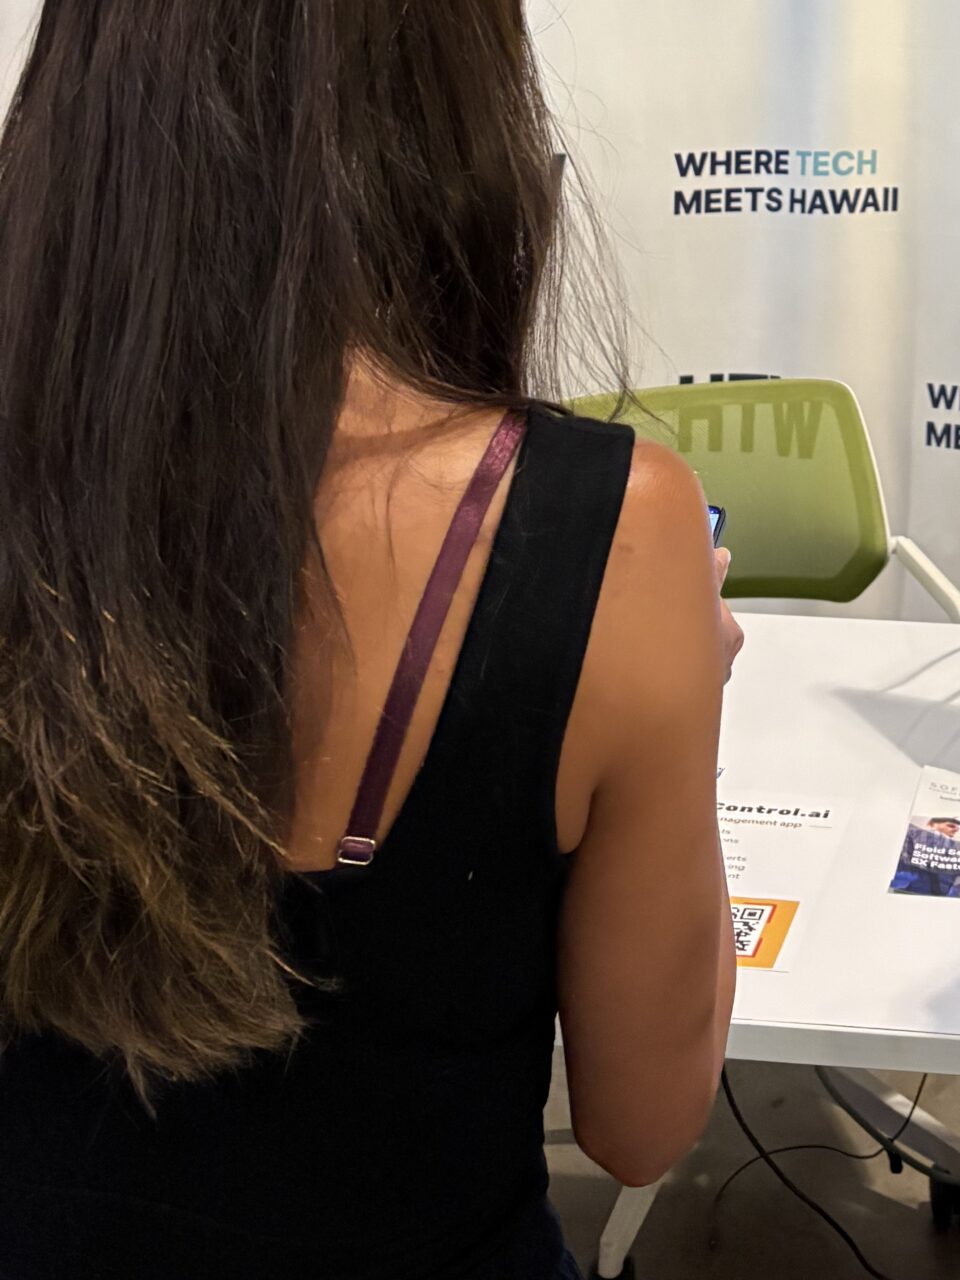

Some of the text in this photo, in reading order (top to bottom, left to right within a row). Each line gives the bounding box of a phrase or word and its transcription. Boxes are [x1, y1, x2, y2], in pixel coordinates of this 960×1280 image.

[675, 149, 877, 177] WHERE TECH
[673, 187, 899, 215] MEETS HAWAII
[720, 816, 802, 829] nagement app
